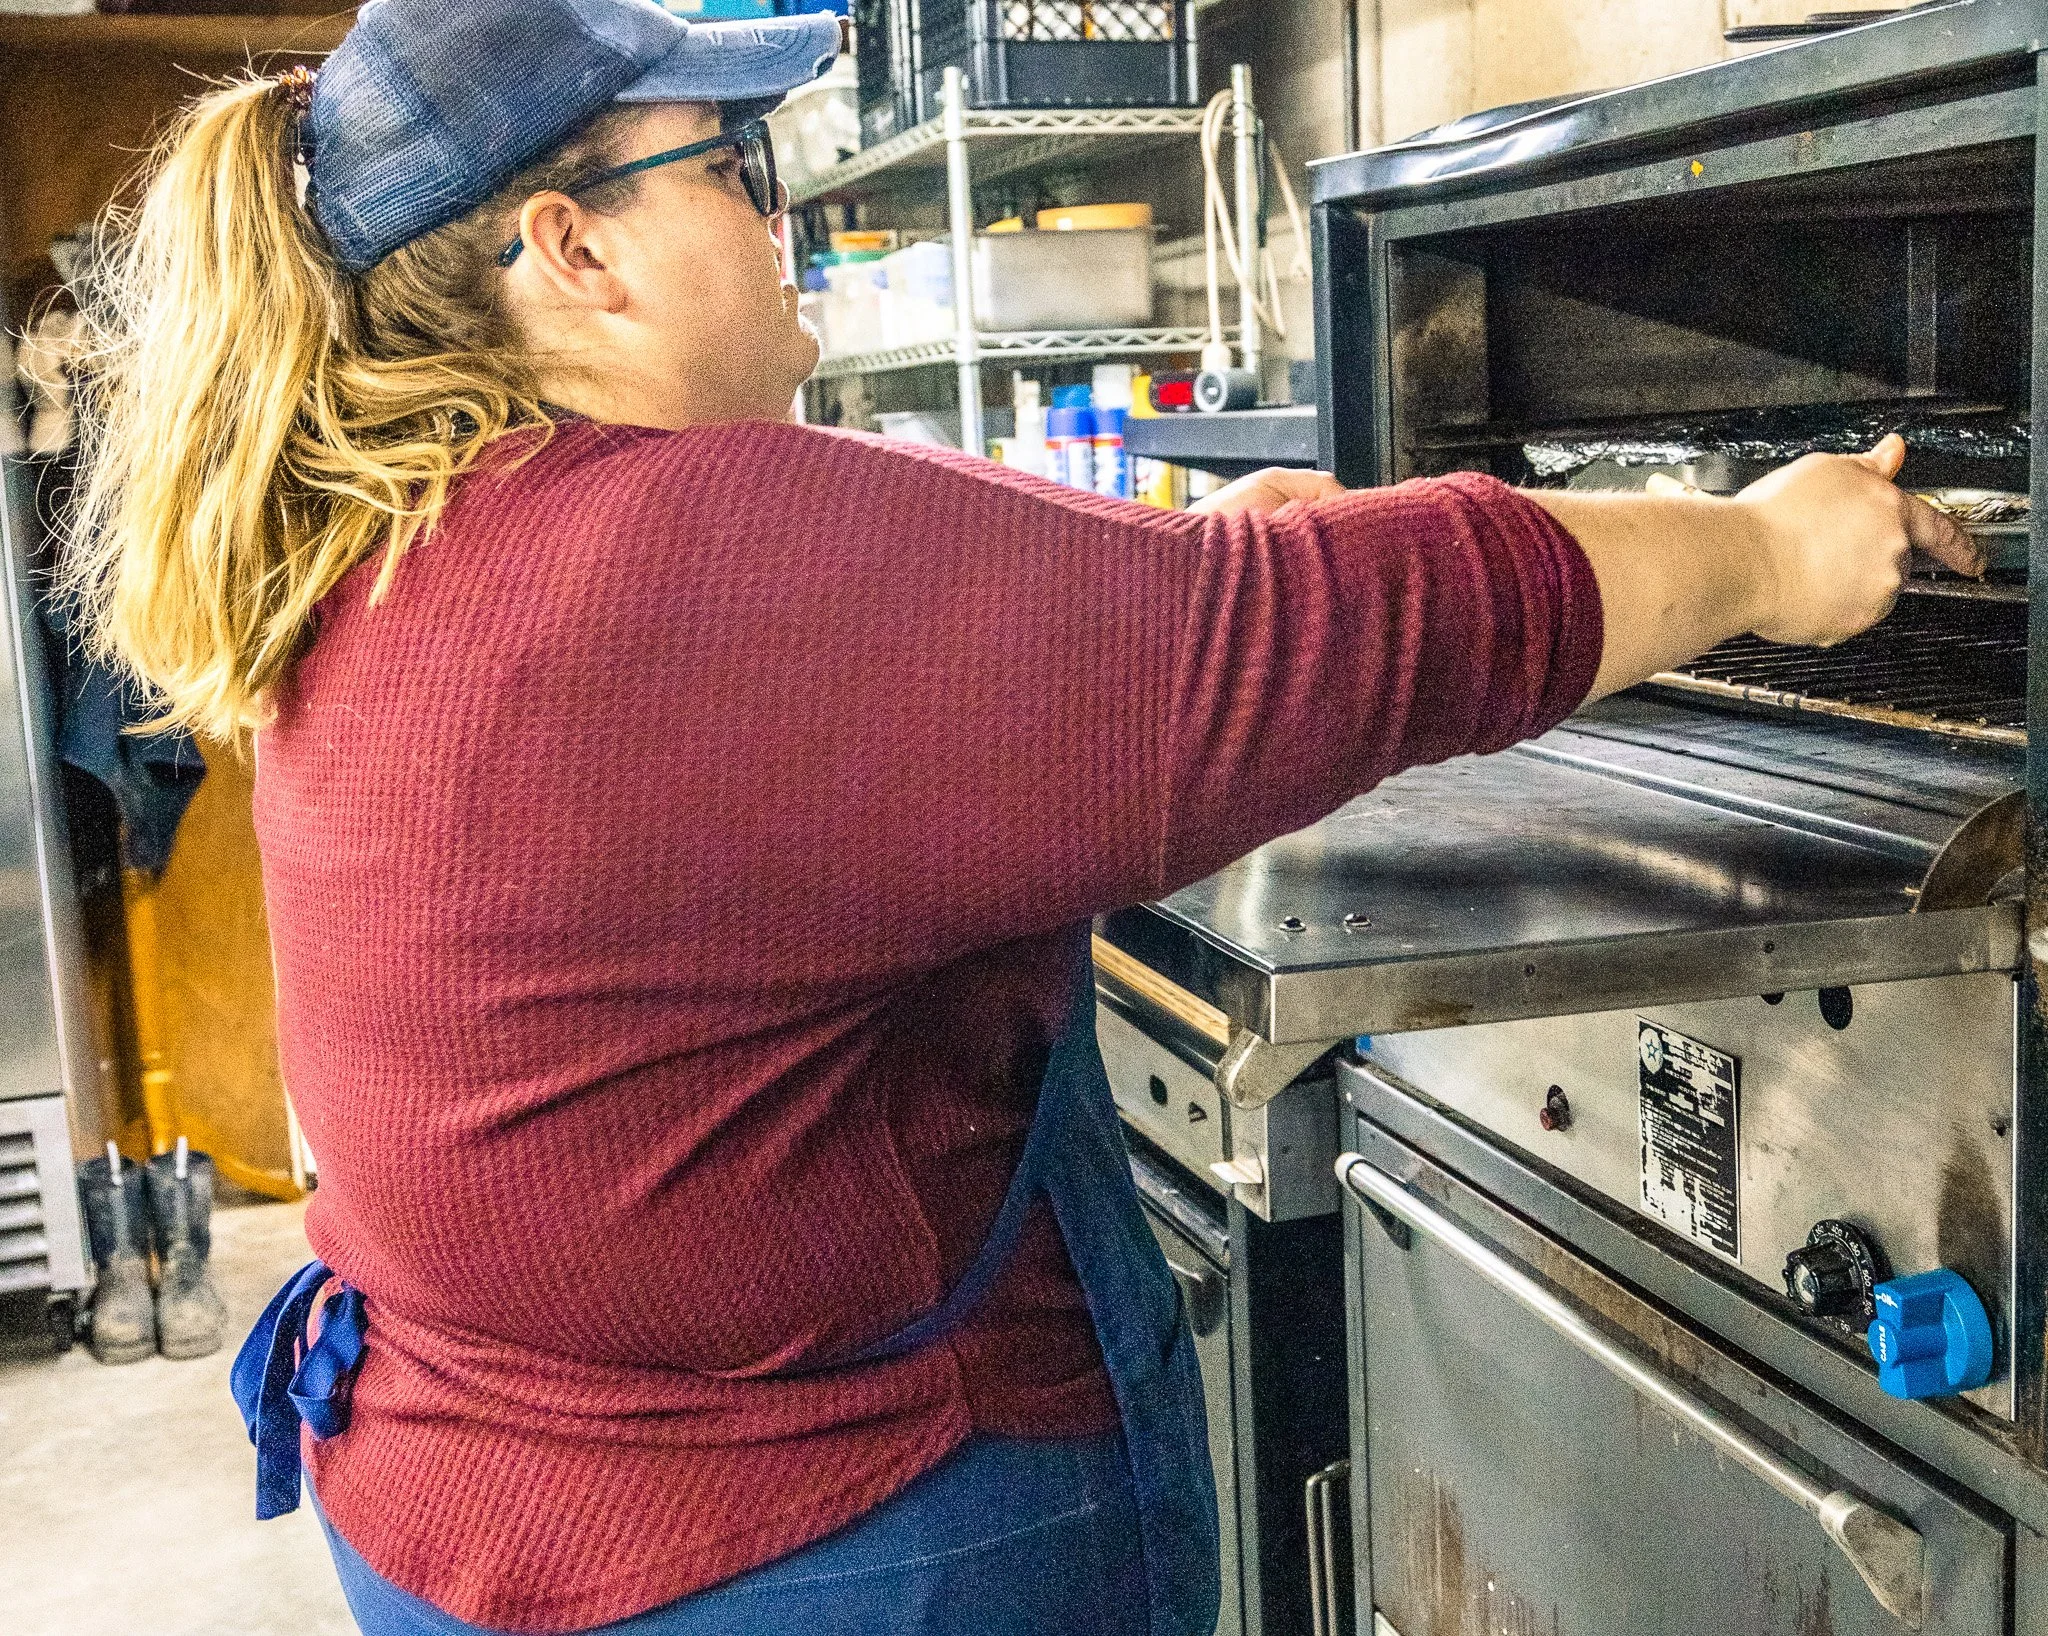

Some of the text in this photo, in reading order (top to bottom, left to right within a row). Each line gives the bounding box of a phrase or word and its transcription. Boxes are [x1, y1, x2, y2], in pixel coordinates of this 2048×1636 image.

[1849, 1241, 1861, 1257] 450
[1862, 1269, 1872, 1287] 500
[1878, 1324, 1887, 1363] CASTLE
